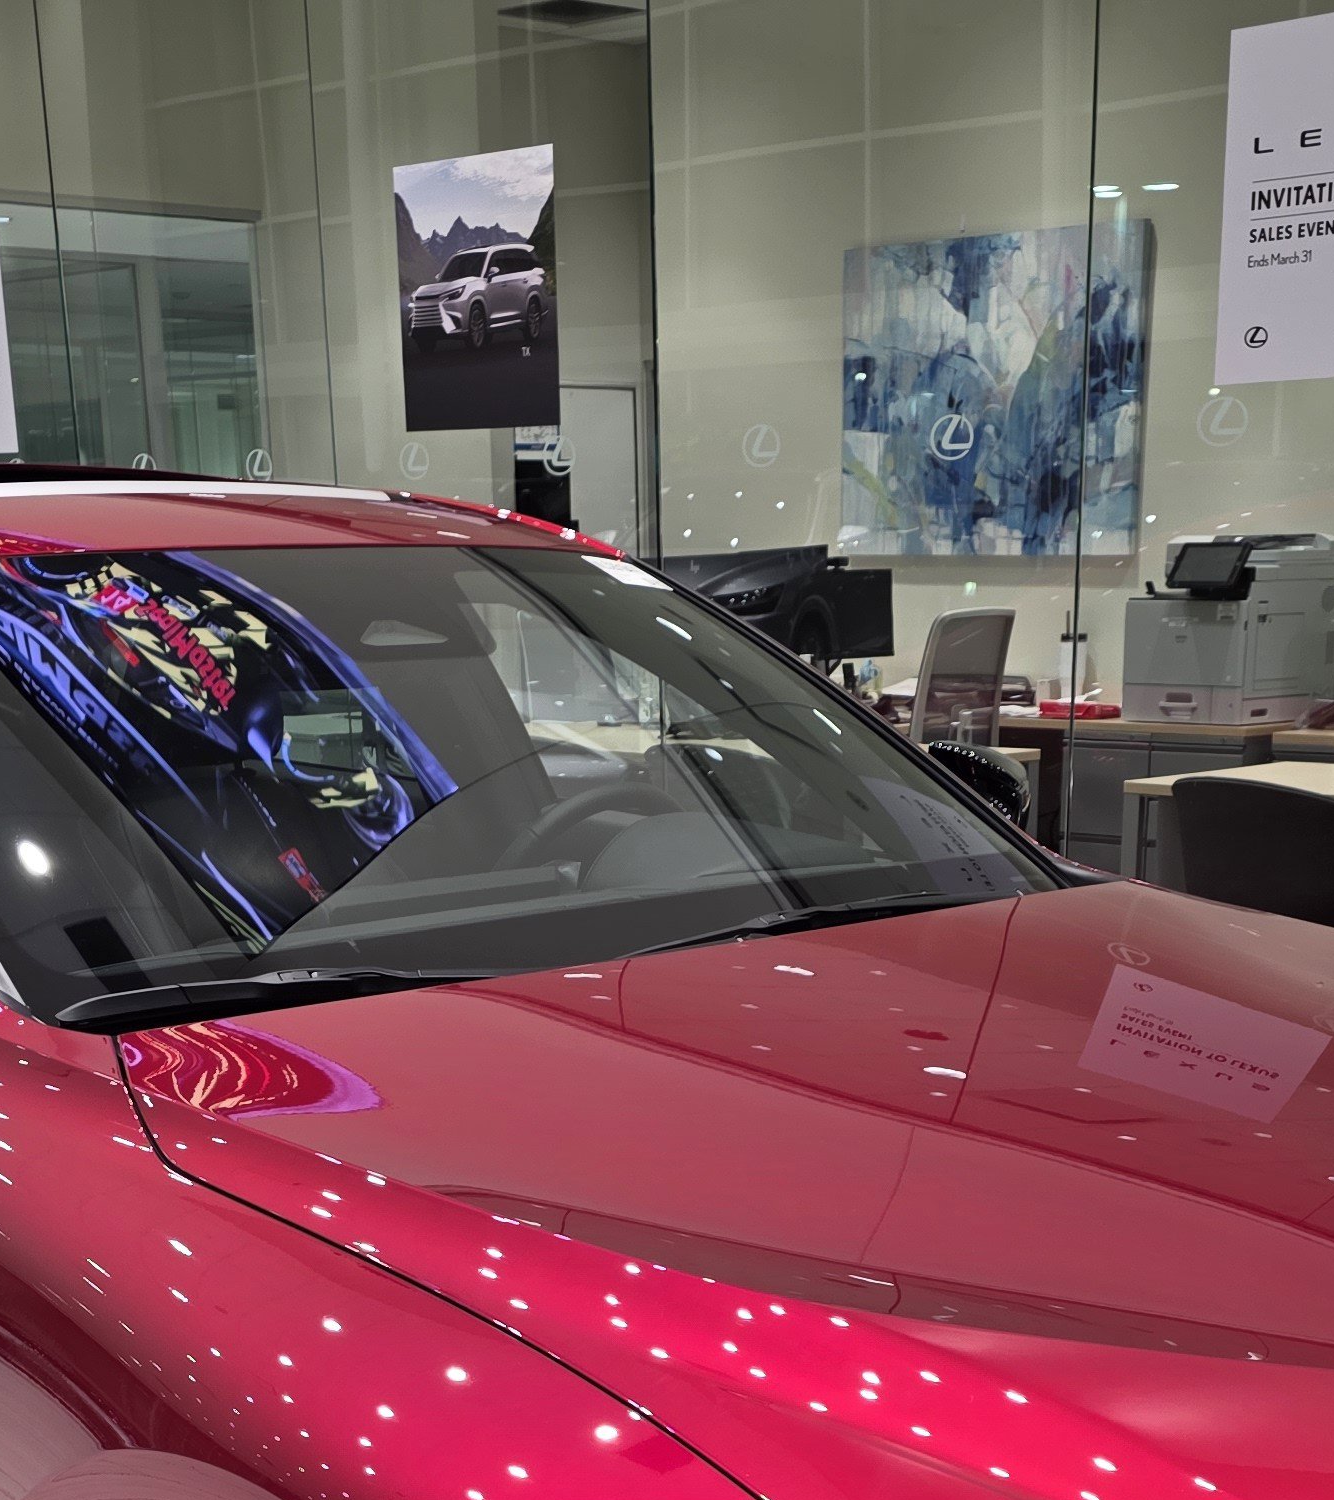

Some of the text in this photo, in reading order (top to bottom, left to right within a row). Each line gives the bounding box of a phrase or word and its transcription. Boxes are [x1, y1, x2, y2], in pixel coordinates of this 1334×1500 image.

[1249, 224, 1293, 243] SALES
[1247, 250, 1313, 268] Ends March 31
